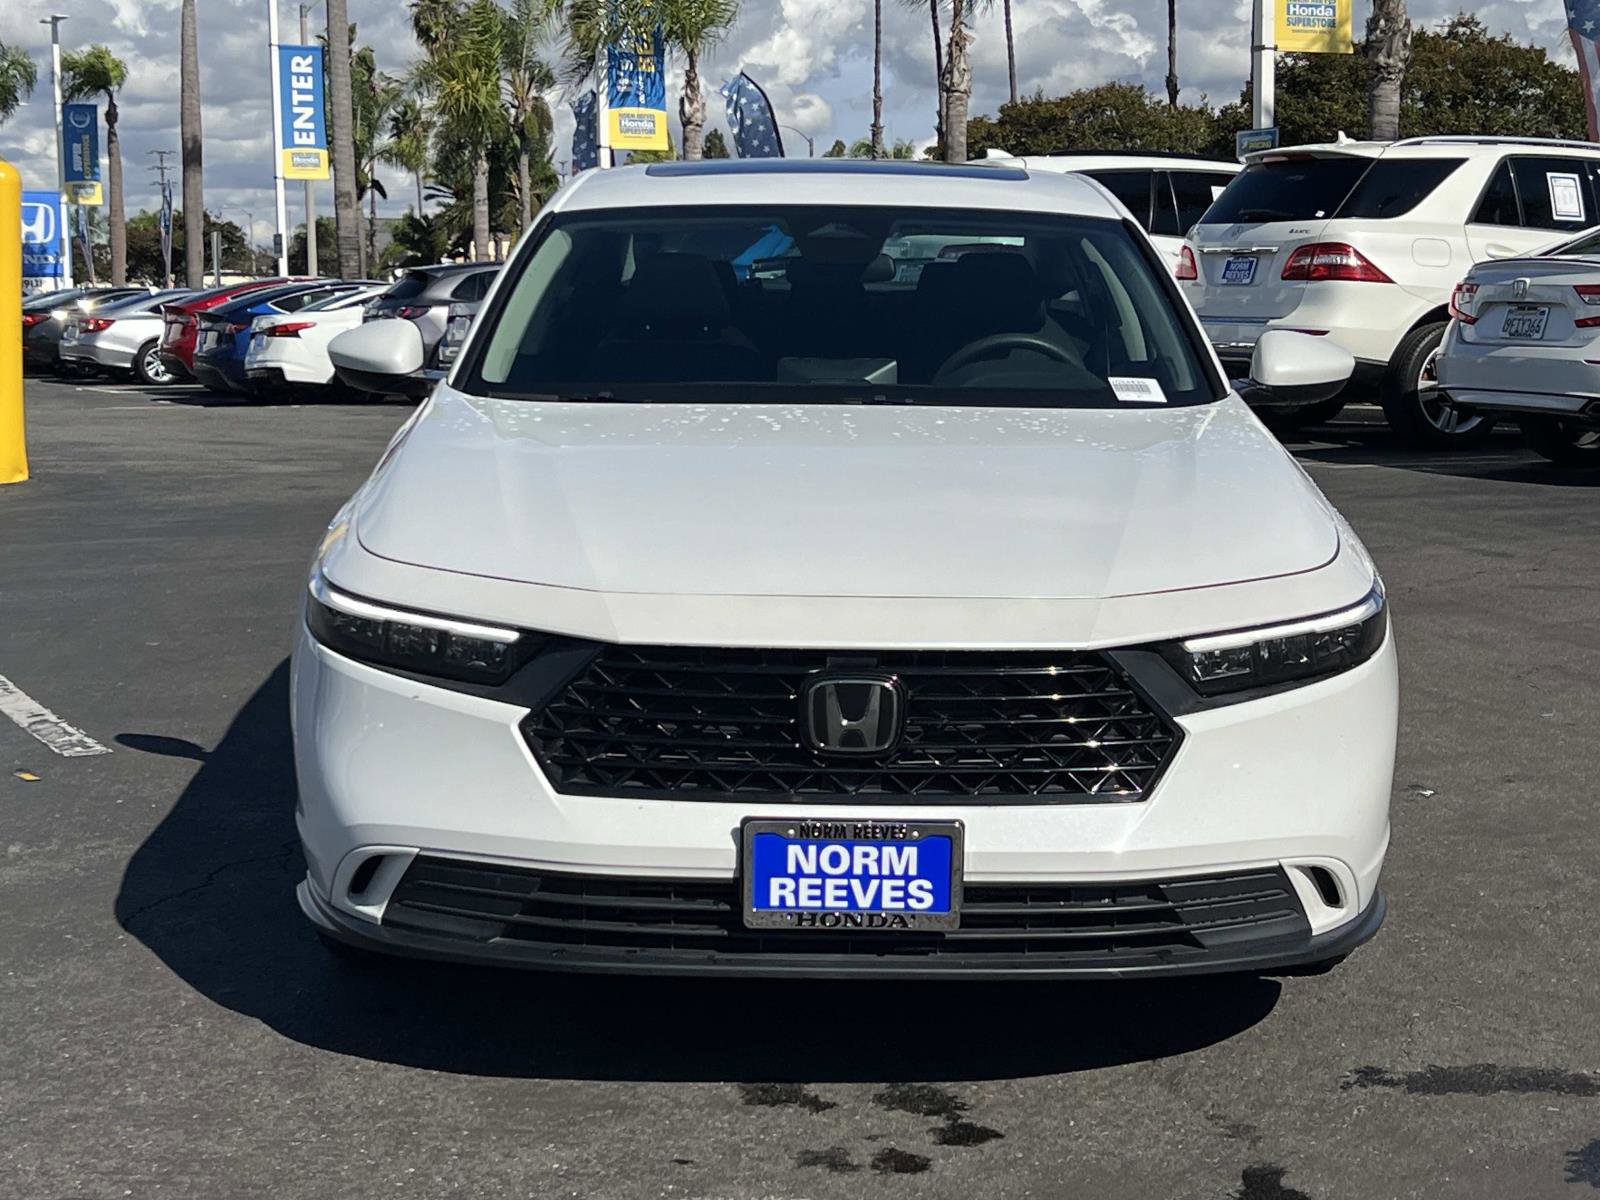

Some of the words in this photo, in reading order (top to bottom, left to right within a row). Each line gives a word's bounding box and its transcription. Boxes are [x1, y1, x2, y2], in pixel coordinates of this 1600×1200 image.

[1289, 4, 1334, 16] Honda
[1286, 17, 1337, 28] SUPERSTORE
[290, 54, 316, 145] ENTER
[622, 119, 654, 128] Honda
[800, 824, 847, 839] NORM
[853, 824, 907, 839] REEVES
[787, 844, 918, 876] NORM
[769, 877, 934, 909] REEVES
[795, 912, 911, 928] HONDA
